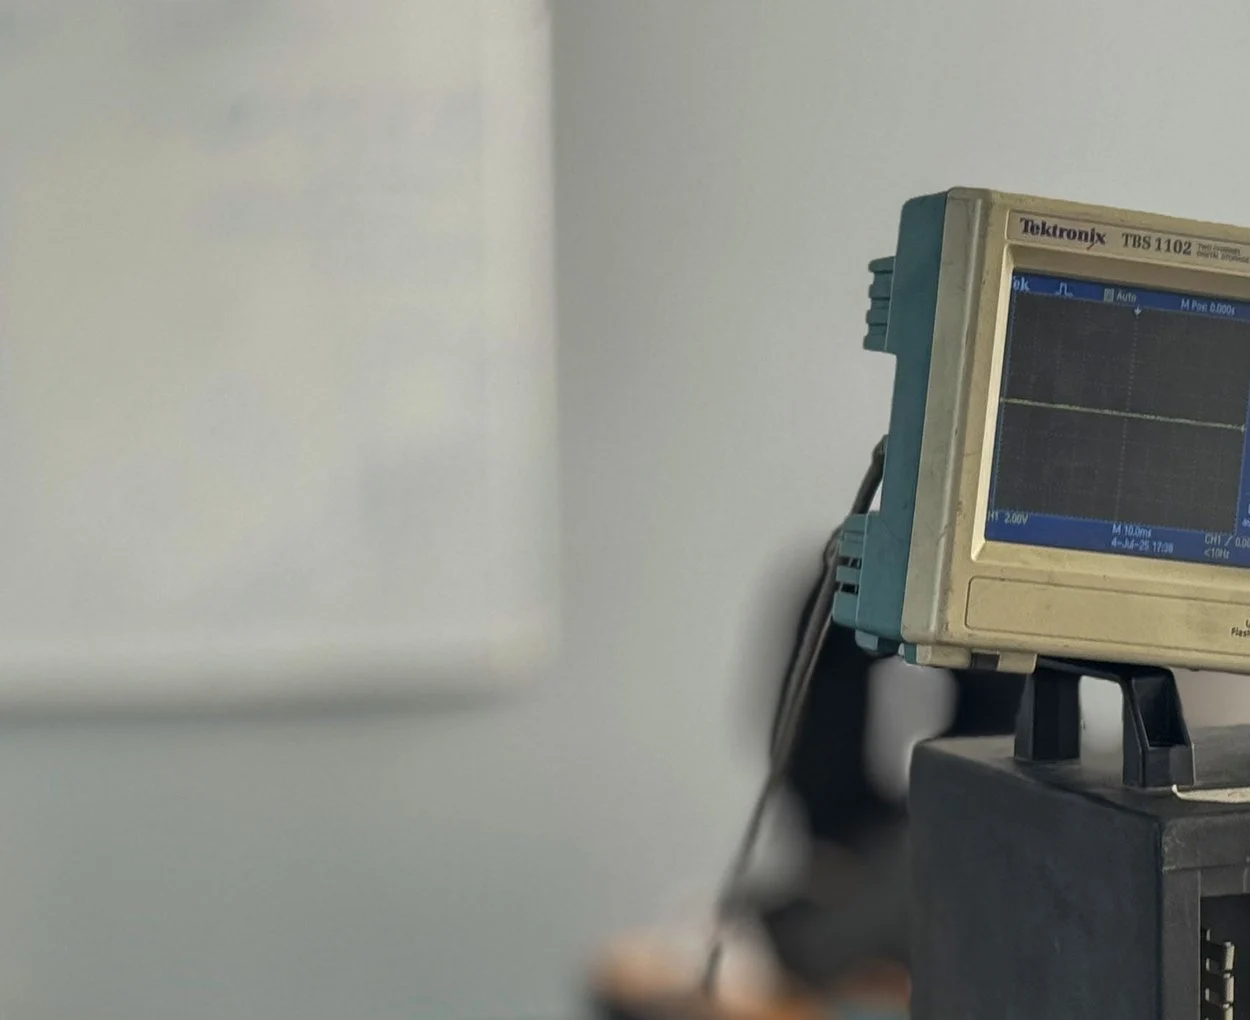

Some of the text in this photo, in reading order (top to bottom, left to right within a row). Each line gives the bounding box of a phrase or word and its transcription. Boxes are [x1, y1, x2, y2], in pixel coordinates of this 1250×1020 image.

[1020, 217, 1192, 256] Tektronix TBS 1102
[1012, 275, 1030, 292] ek
[1116, 289, 1136, 302] Auto
[1181, 298, 1190, 309] M
[1003, 512, 1030, 525] 2.00V
[1112, 523, 1121, 535] M
[1204, 533, 1221, 545] CH1
